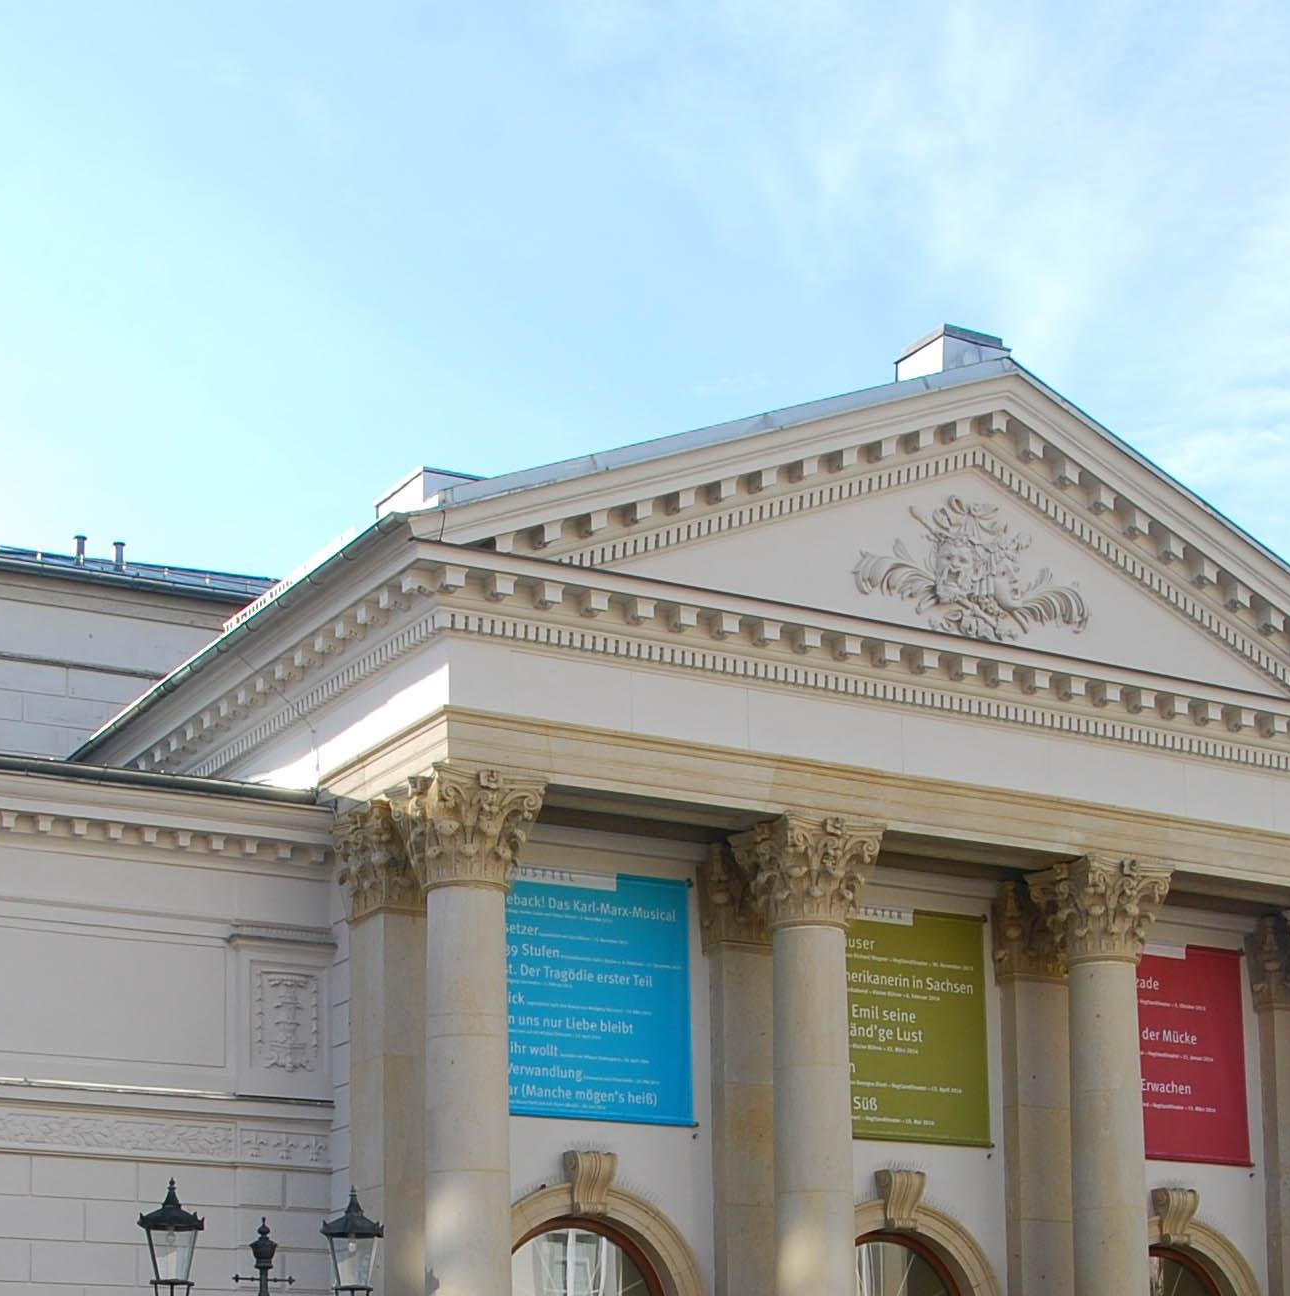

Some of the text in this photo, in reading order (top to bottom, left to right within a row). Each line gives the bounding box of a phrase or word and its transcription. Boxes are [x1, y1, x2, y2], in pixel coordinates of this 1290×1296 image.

[548, 897, 570, 911] Das
[573, 900, 677, 923] Karl-Marx-Musical
[522, 944, 560, 958] Stufen
[846, 938, 875, 950] user
[520, 964, 541, 977] Der
[544, 966, 594, 983] Tragödie
[597, 972, 630, 986] erster
[633, 975, 653, 988] Teil
[912, 976, 923, 989] in
[926, 978, 974, 995] Sachsen
[852, 1004, 917, 1024] Emil seine
[518, 1016, 540, 1026] uns
[543, 1018, 562, 1028] nur
[565, 1016, 598, 1032] Liebe
[600, 1020, 634, 1034] bleibt
[849, 1023, 923, 1043] änd'ge Lust
[1142, 1028, 1197, 1045] der Mücke
[510, 1042, 558, 1057] ihr wollt
[521, 1083, 573, 1099] (Manche
[575, 1089, 625, 1105] mögen's
[627, 1091, 658, 1107] heiß)
[1141, 1078, 1192, 1095] Erwachen
[853, 1096, 878, 1111] Süß
